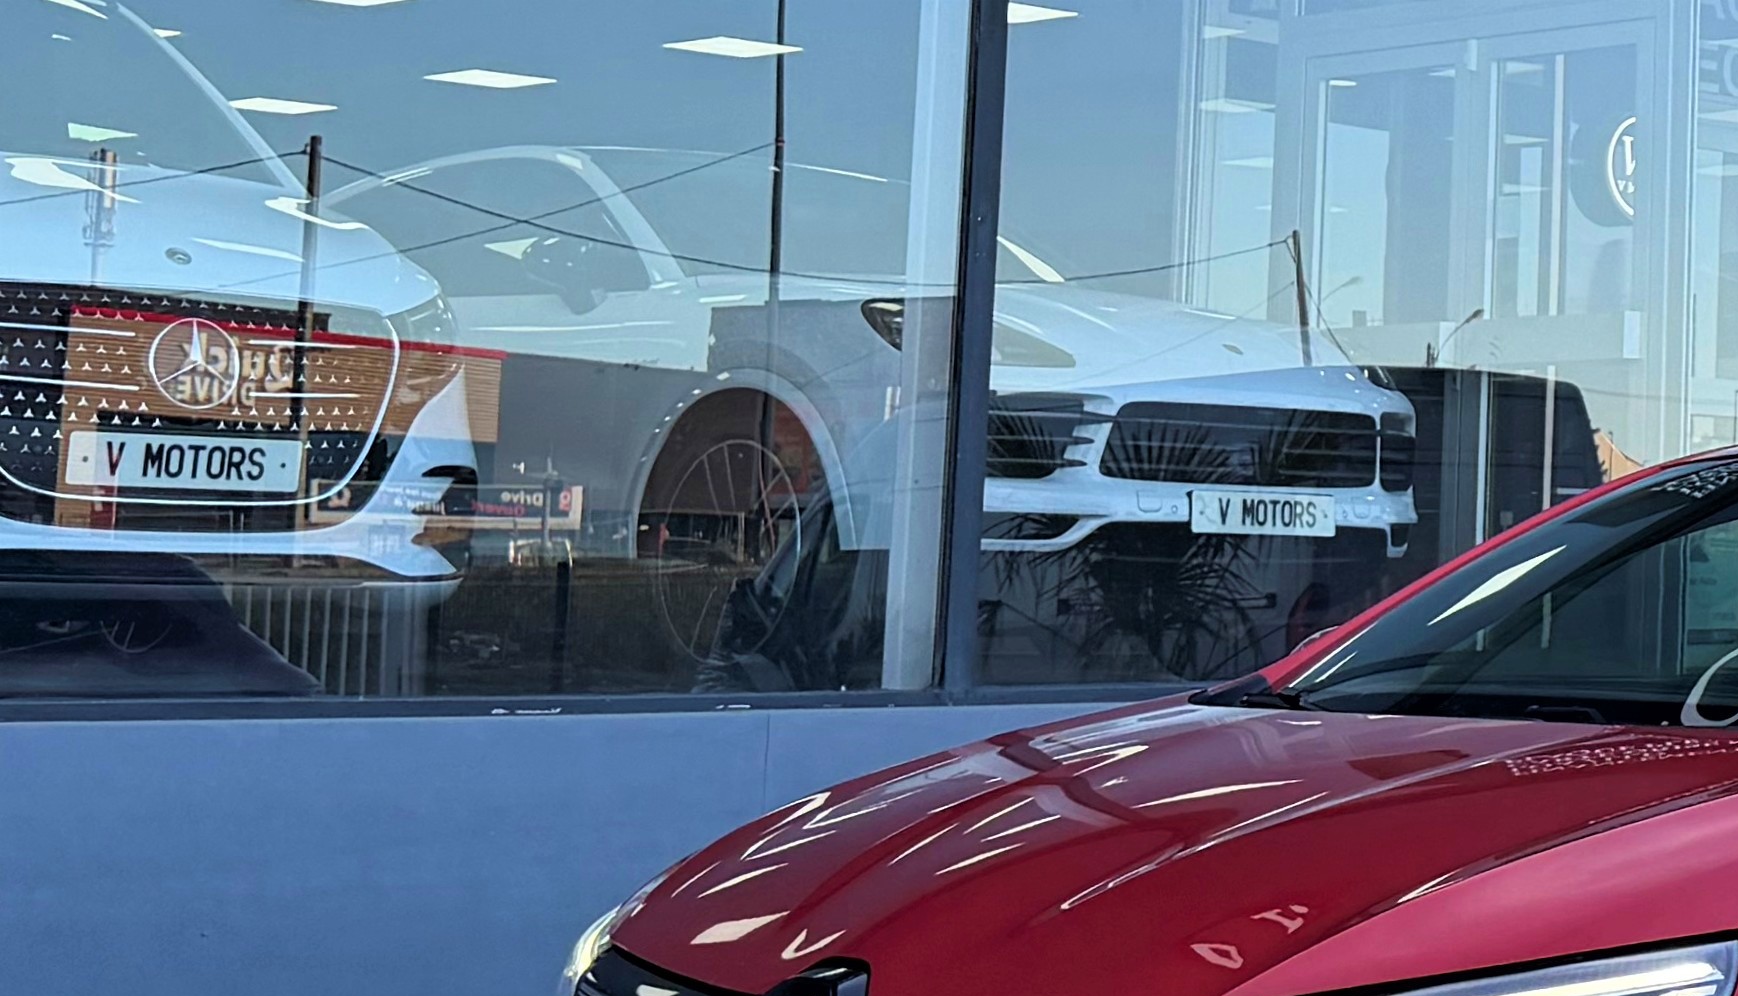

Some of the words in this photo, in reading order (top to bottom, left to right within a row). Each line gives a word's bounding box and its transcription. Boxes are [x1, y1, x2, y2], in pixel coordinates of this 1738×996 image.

[107, 441, 126, 477] V
[142, 443, 266, 481] MOTORS
[1218, 497, 1230, 525] V
[1242, 498, 1317, 528] MOTORS
